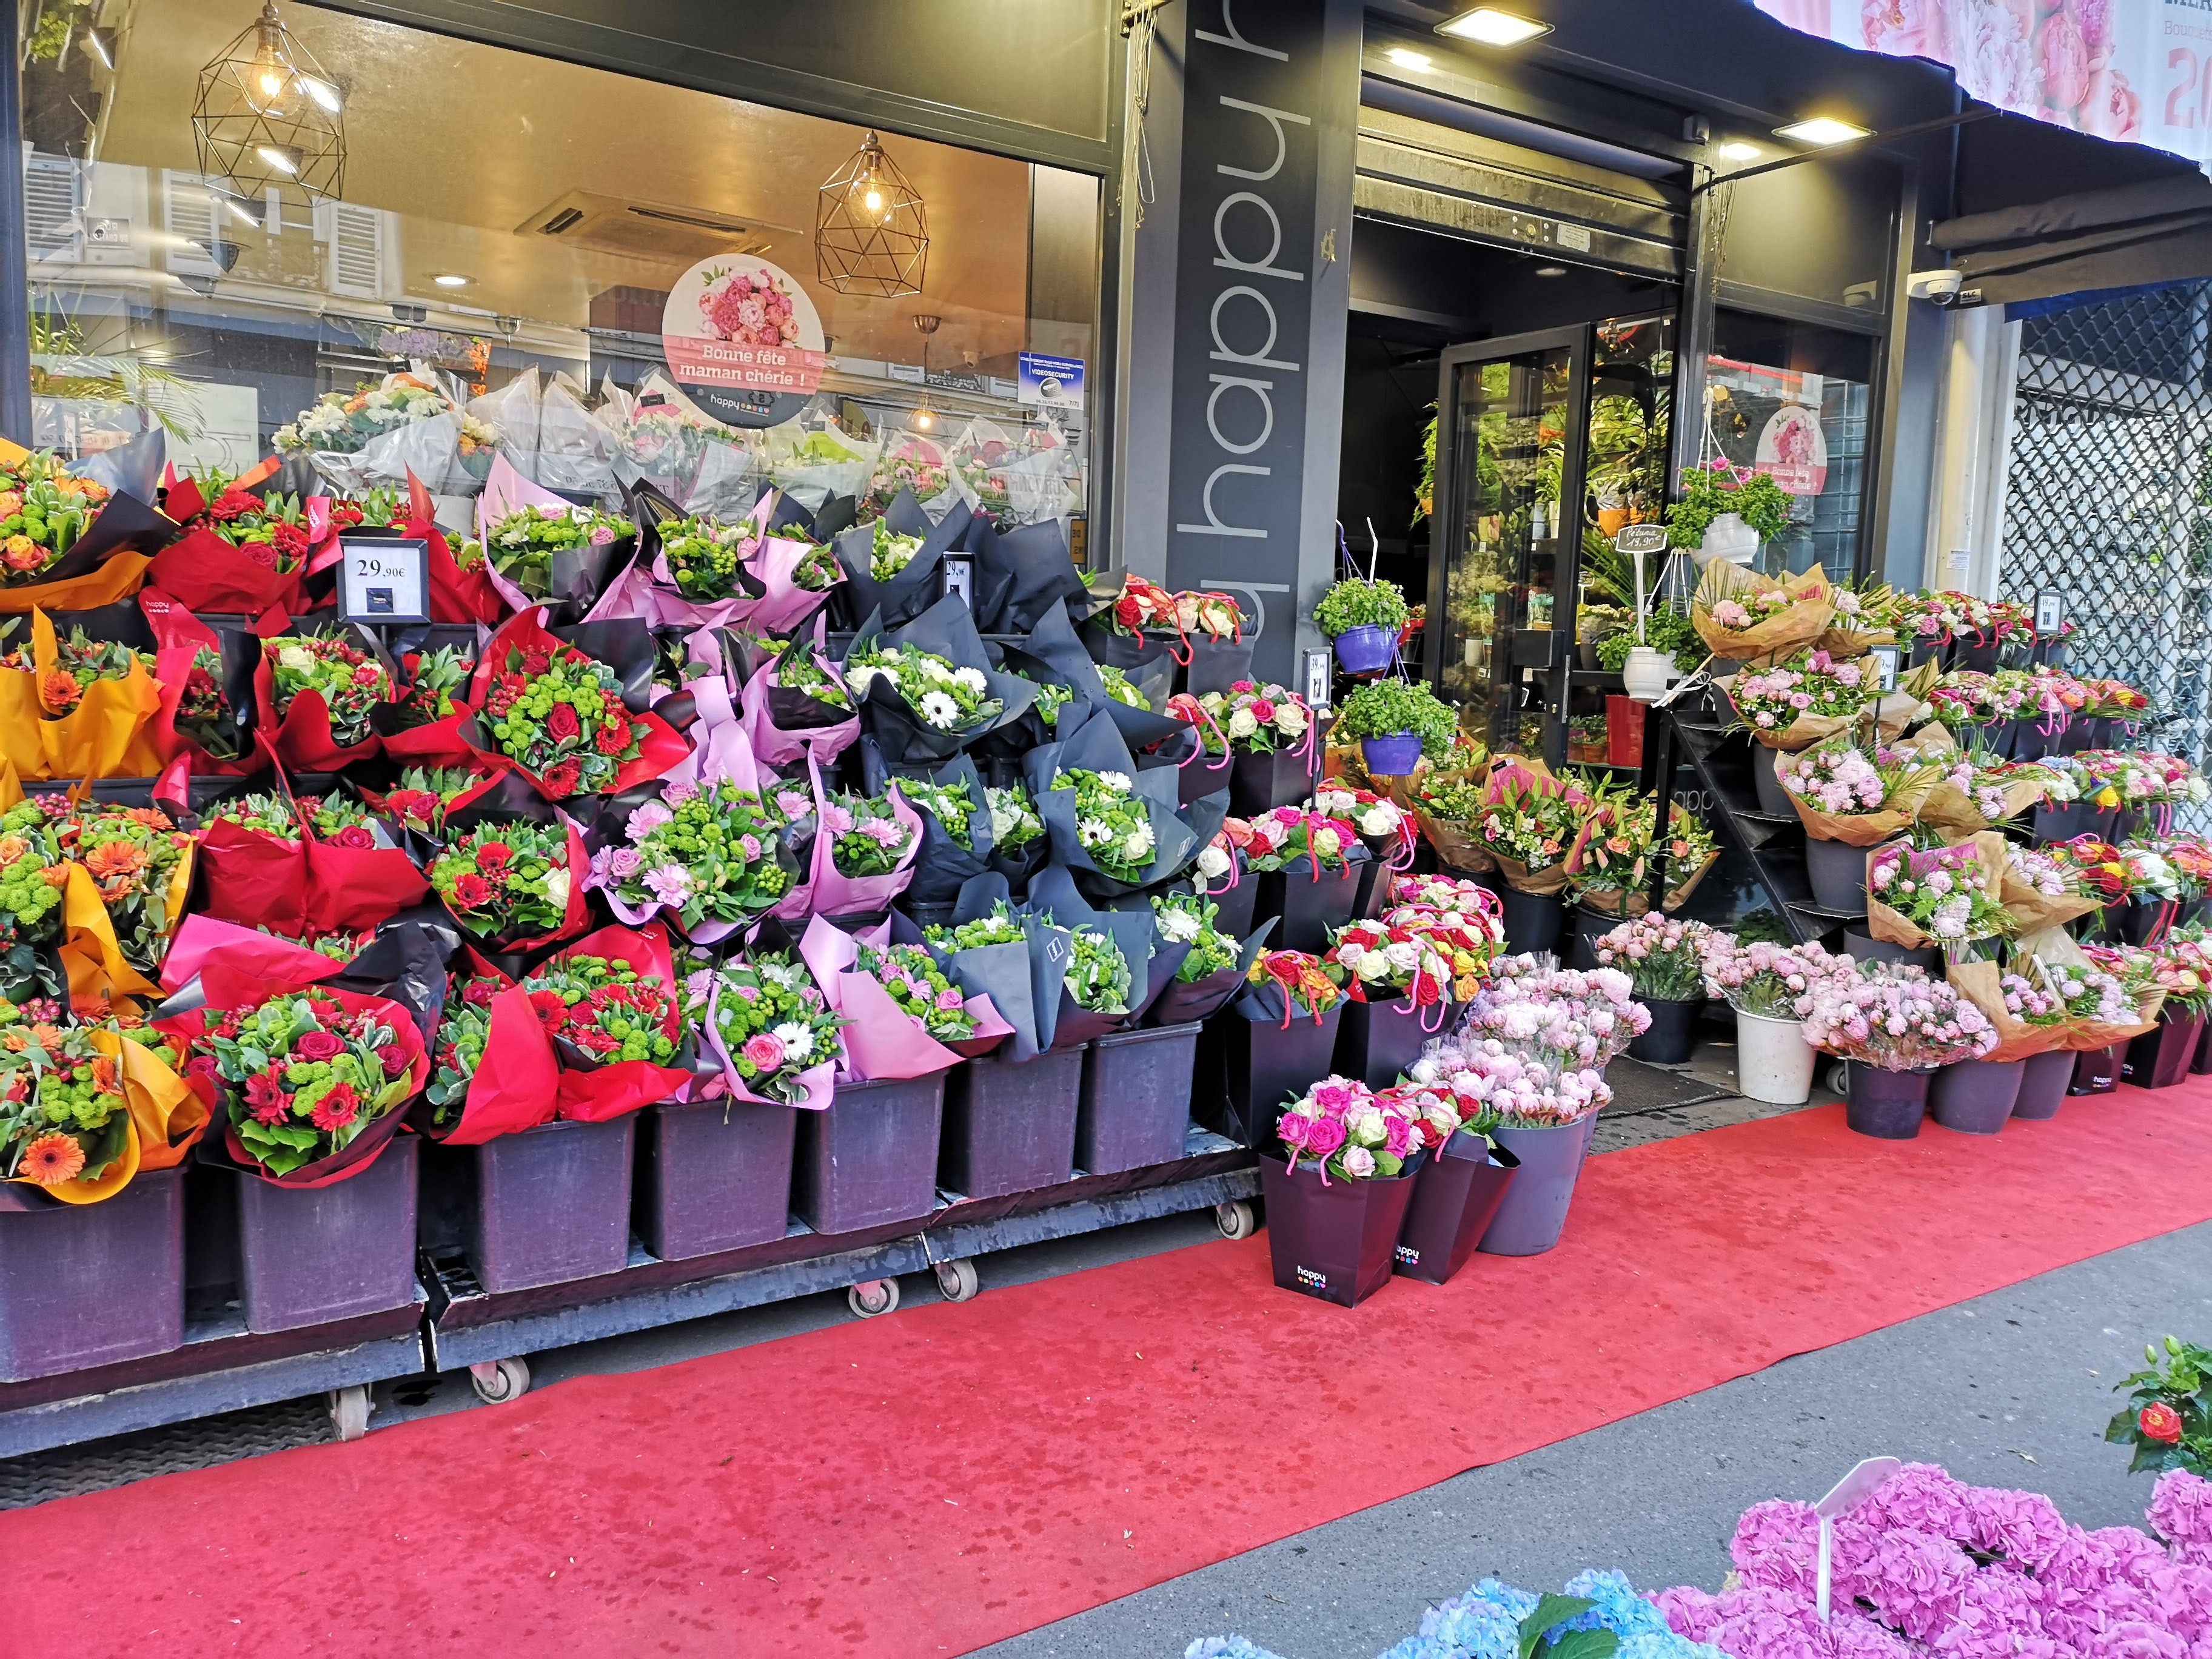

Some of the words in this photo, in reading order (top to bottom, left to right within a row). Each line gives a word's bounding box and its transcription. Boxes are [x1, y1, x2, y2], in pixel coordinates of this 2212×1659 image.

[1176, 95, 1312, 538] happy
[702, 344, 754, 363] Bonne
[756, 350, 786, 366] fête
[679, 364, 742, 381] maman
[745, 369, 794, 386] chérie
[1031, 368, 1074, 380] VIDEOSECURITY
[710, 394, 740, 411] happy
[356, 559, 406, 578] 29,90€
[146, 600, 169, 609] happy
[1396, 1245, 1419, 1259] appy
[1297, 1265, 1327, 1282] happy
